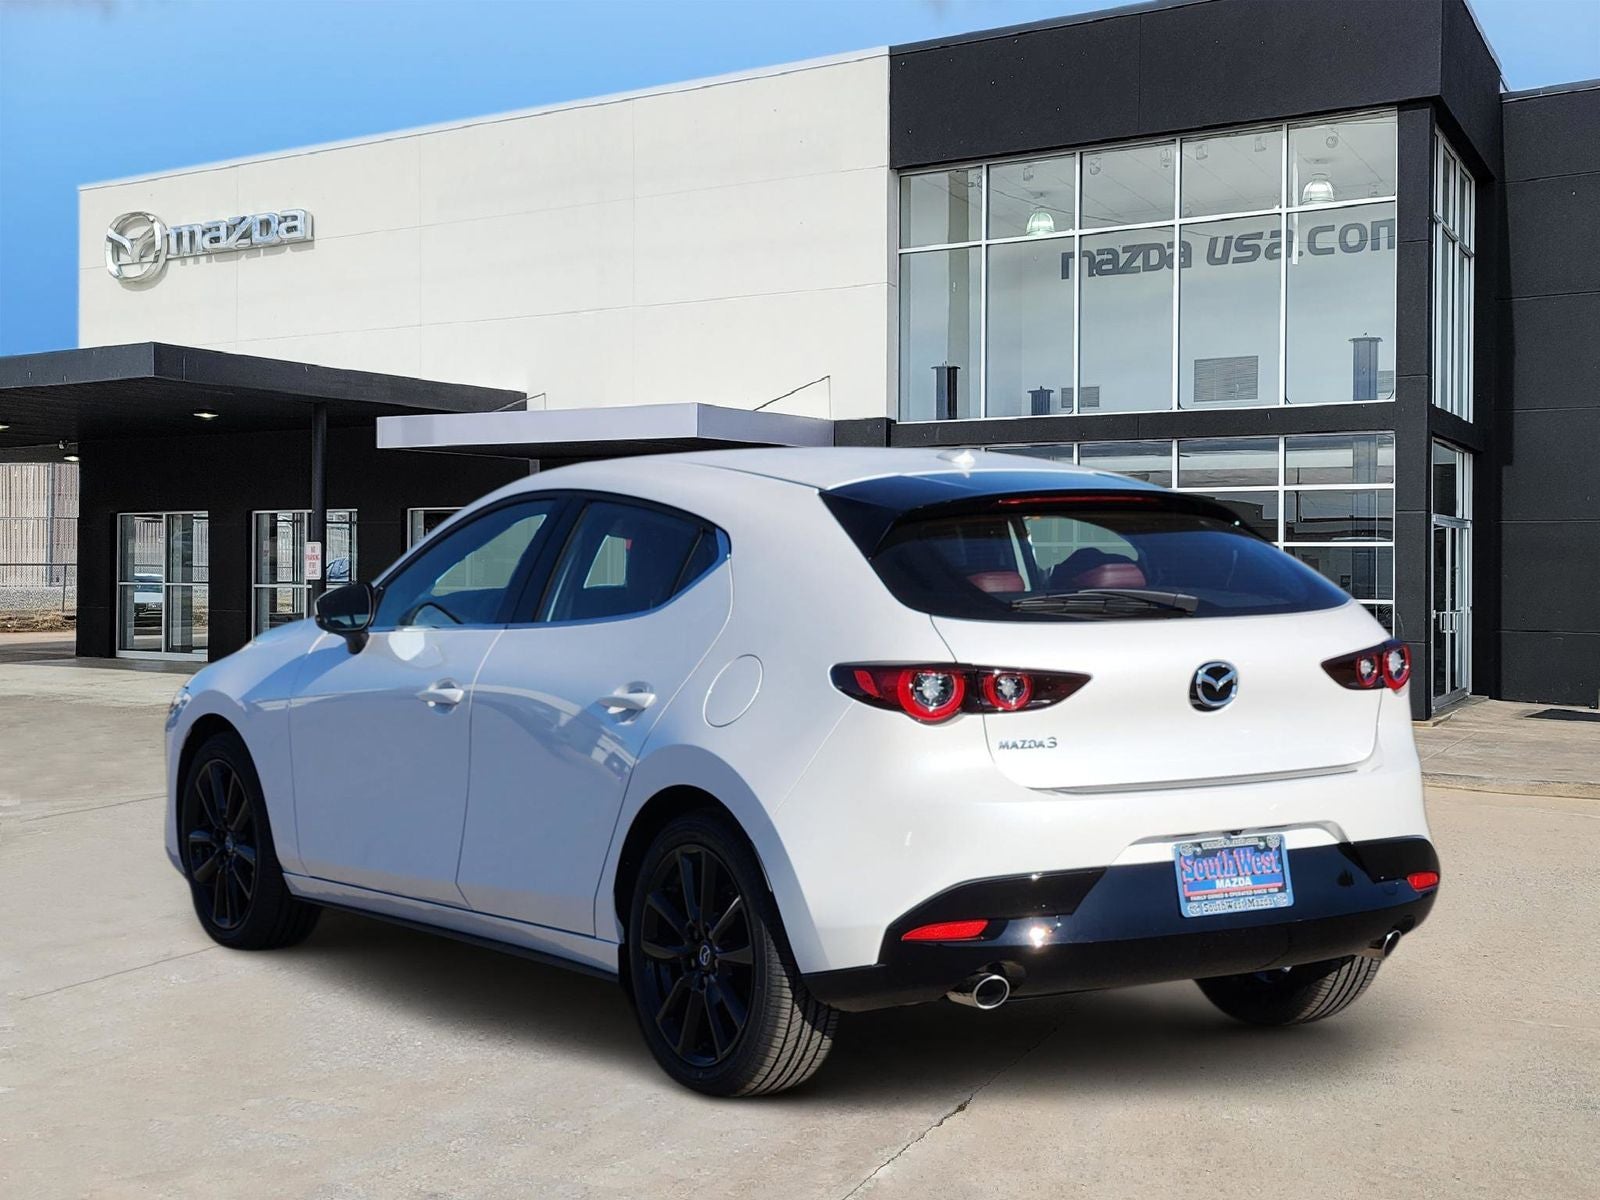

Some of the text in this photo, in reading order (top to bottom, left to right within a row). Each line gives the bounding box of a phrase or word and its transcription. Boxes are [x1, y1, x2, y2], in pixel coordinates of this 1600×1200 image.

[167, 209, 313, 256] mazda
[1061, 238, 1193, 280] mazda
[1215, 876, 1253, 889] MAZDA
[1247, 897, 1273, 909] Mazda
